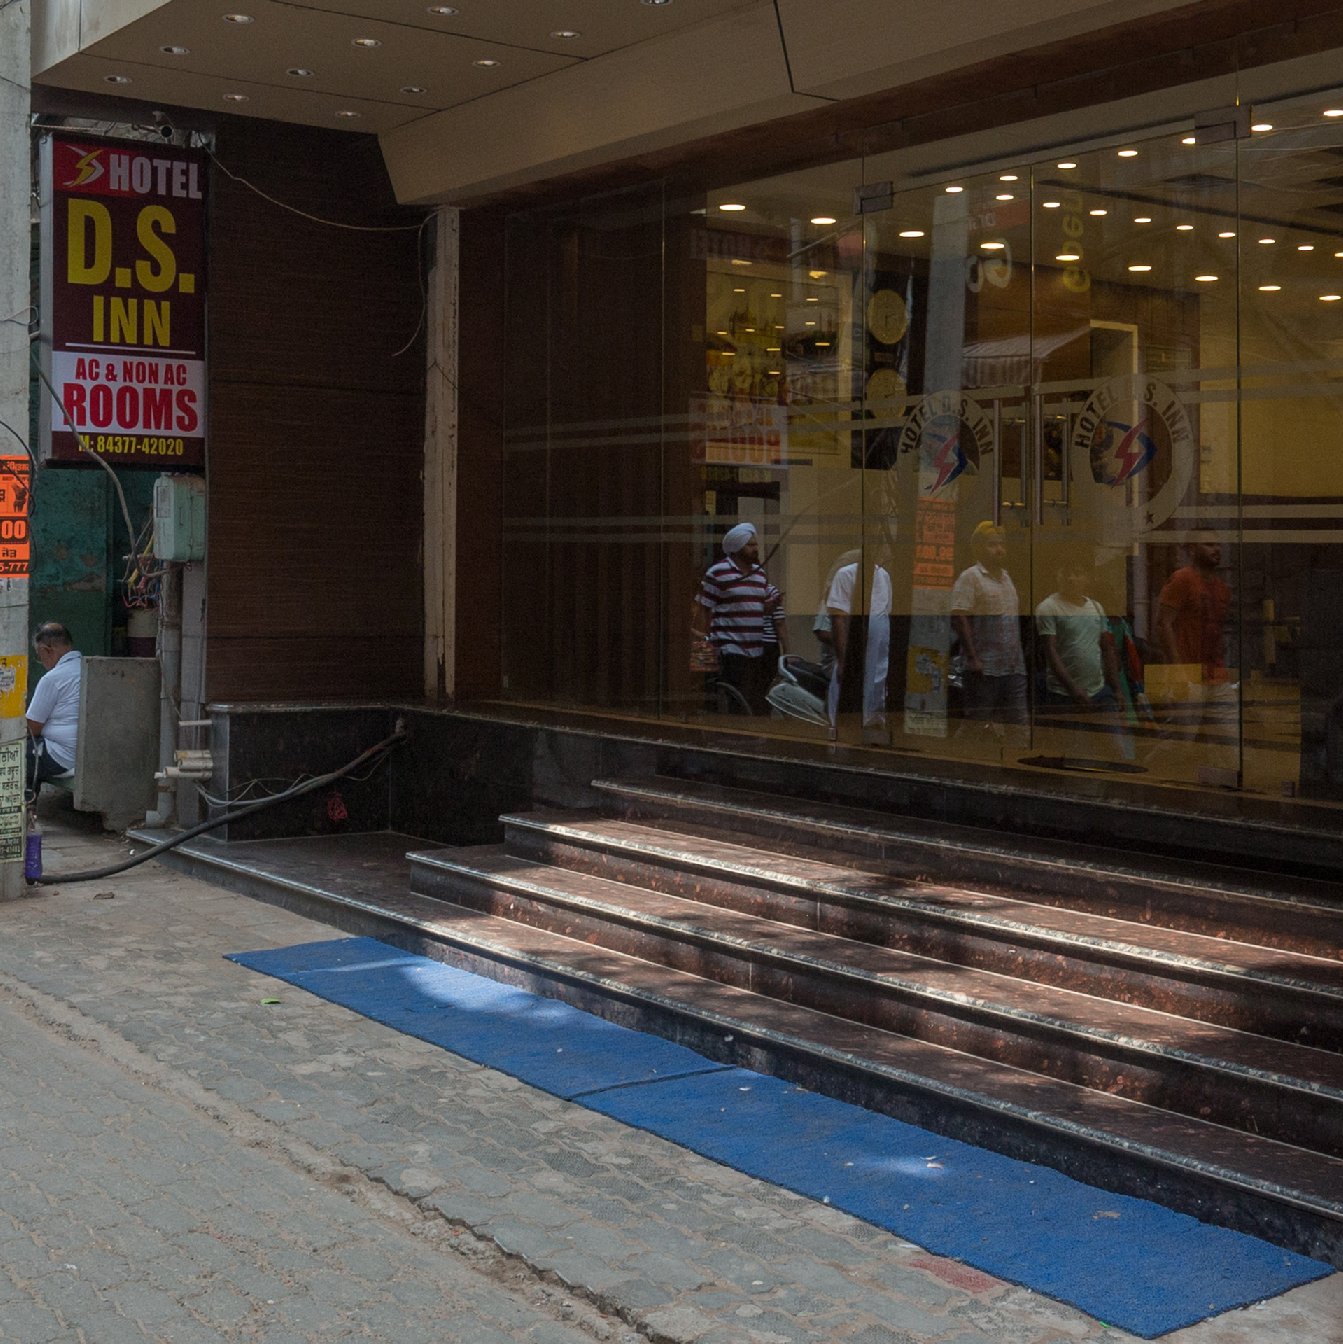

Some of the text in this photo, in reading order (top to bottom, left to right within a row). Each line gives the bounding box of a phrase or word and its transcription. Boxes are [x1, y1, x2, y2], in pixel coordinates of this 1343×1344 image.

[109, 153, 203, 200] HOTEL
[67, 197, 196, 294] D.S.
[92, 294, 171, 347] INN
[75, 357, 188, 386] AC & NON AC
[63, 382, 198, 433] ROOMS
[901, 398, 937, 454] HOTEL
[971, 416, 995, 456] INN
[1074, 385, 1119, 449] HOTEL
[1161, 400, 1190, 443] INN
[96, 436, 184, 456] 84377-42020
